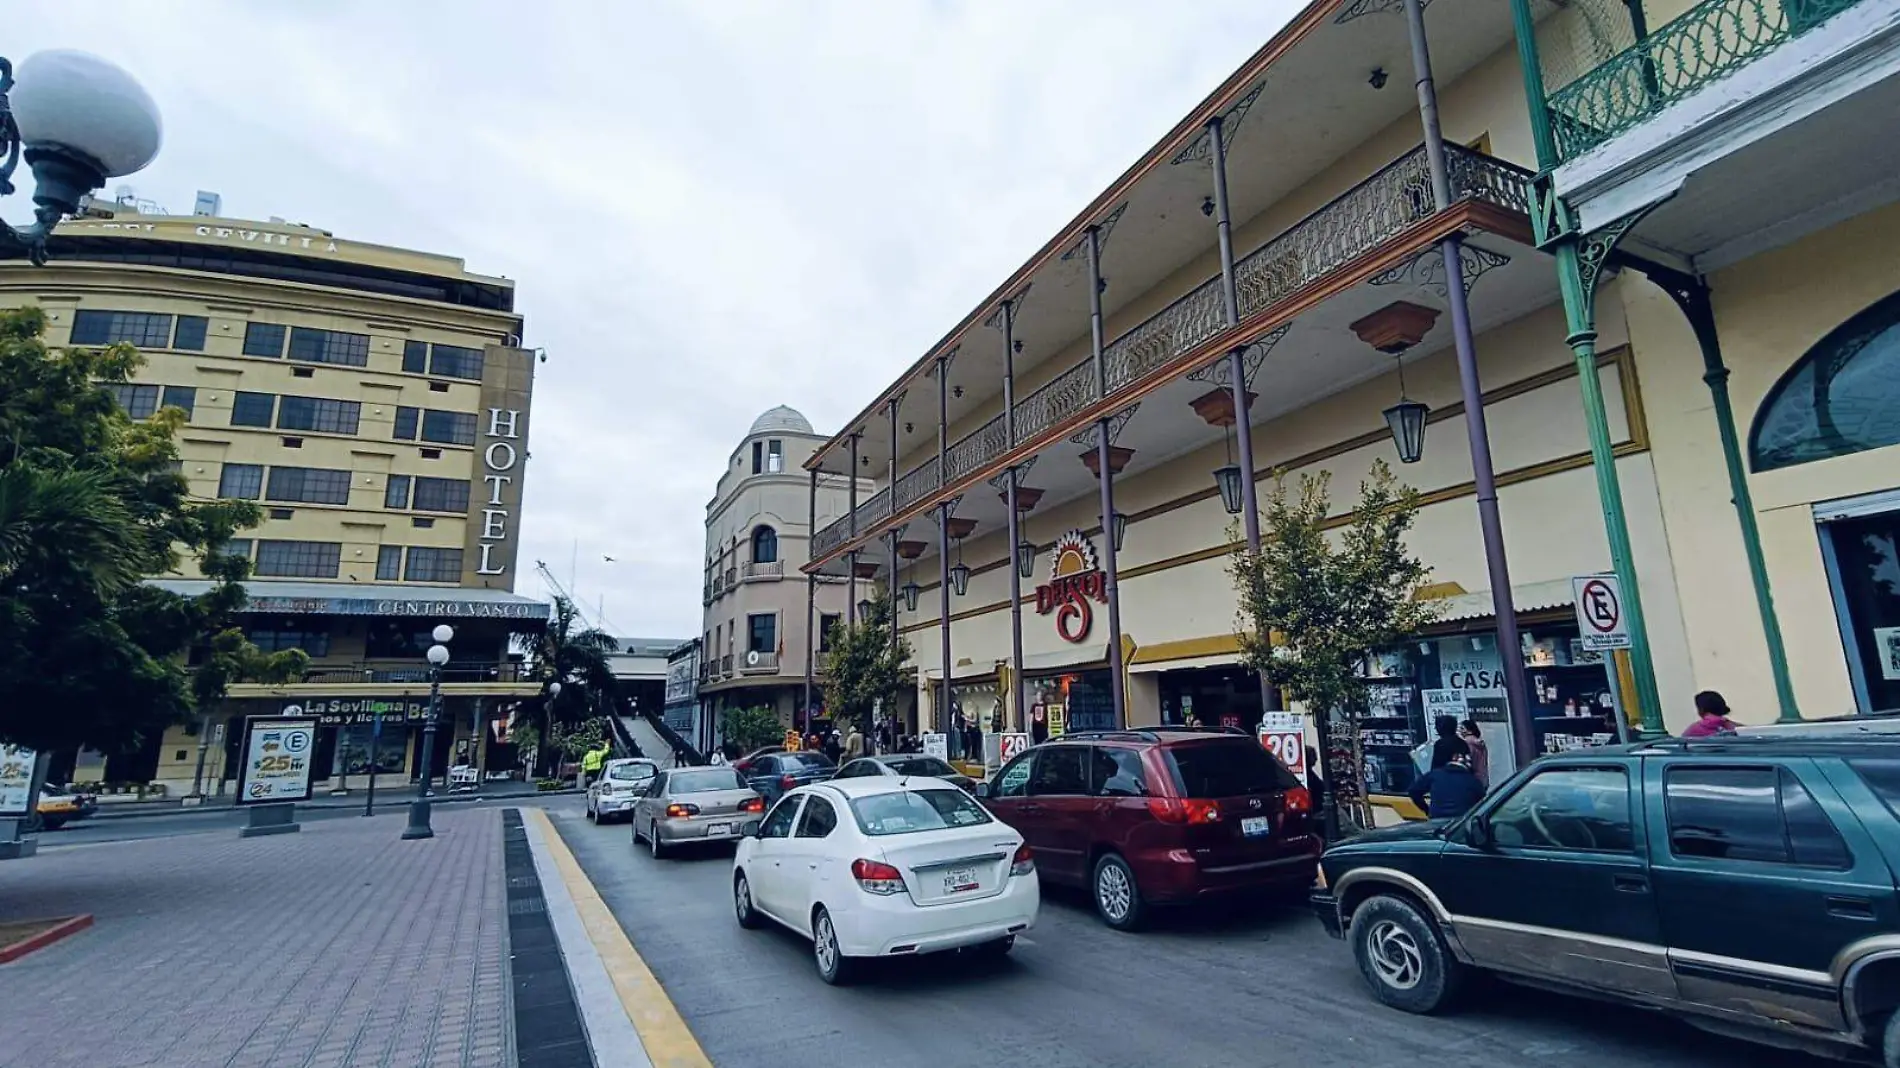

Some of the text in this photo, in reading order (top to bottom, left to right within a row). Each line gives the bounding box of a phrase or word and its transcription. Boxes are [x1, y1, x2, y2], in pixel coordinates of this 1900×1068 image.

[476, 407, 521, 575] HOTEL
[378, 600, 459, 615] CENTRO
[469, 603, 530, 616] VASCO
[1450, 670, 1505, 690] CASA
[305, 700, 404, 713] La Sevillna
[1267, 734, 1300, 766] 20
